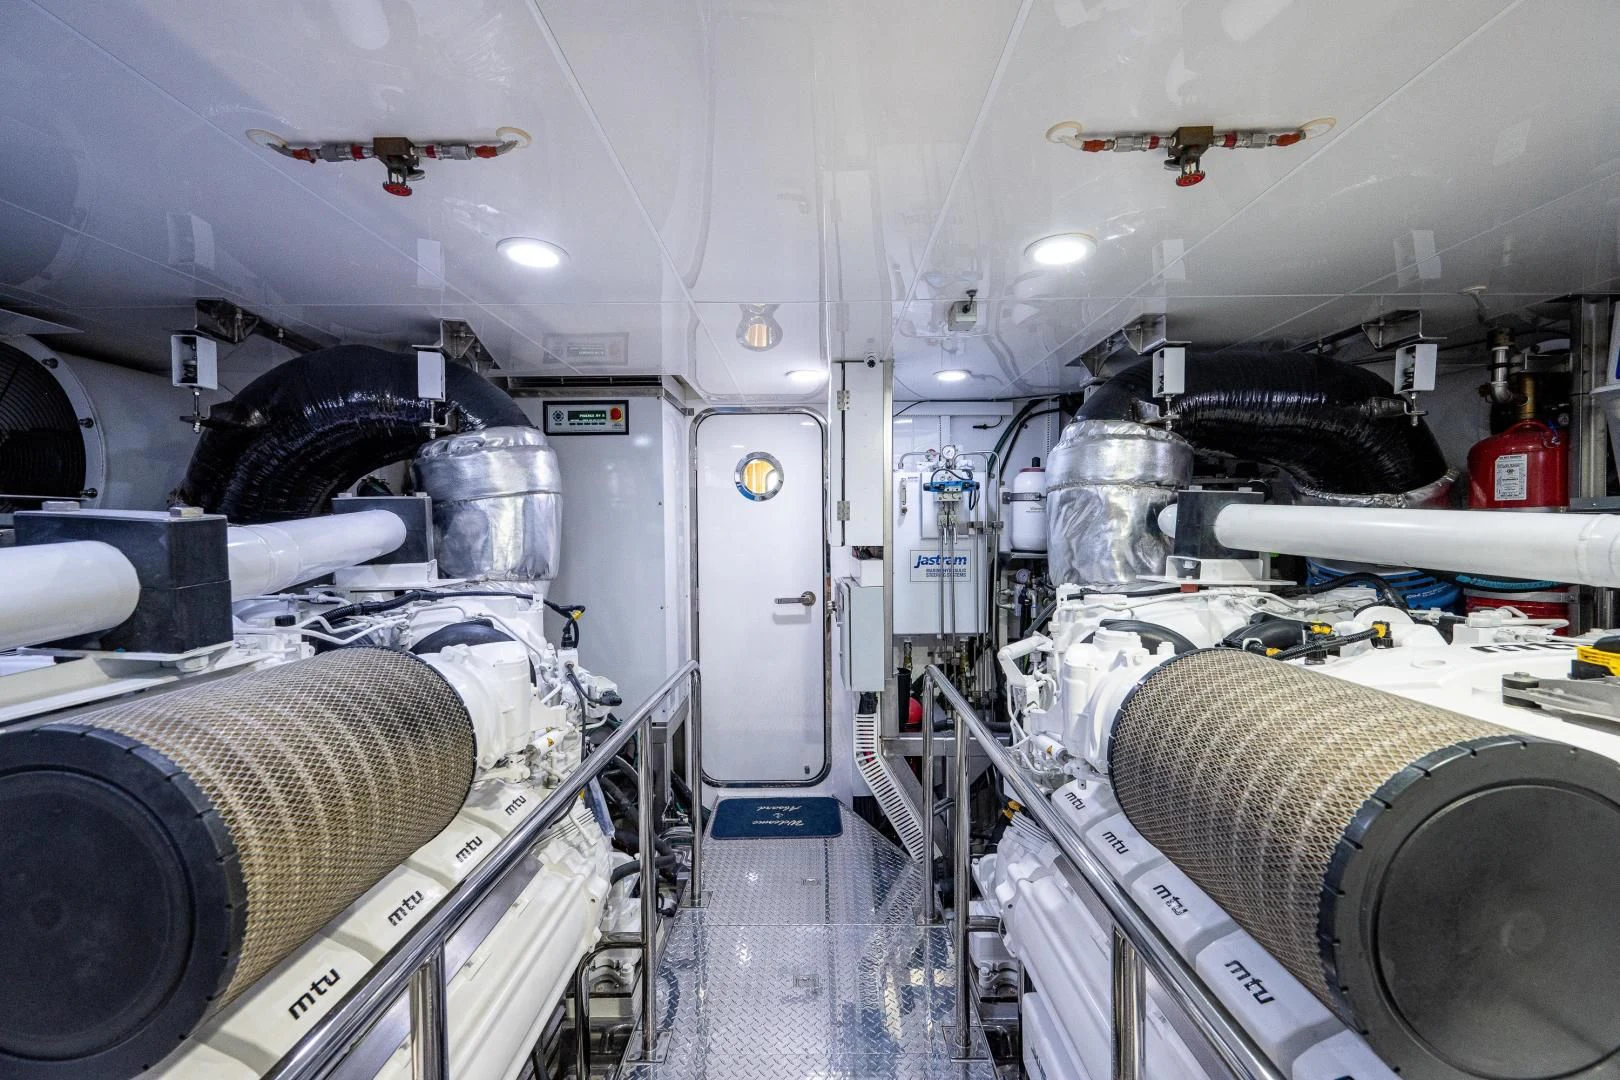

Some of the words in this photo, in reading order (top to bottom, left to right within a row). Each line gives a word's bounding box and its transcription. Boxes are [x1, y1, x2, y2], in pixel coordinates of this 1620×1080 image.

[914, 554, 967, 568] Jastram
[505, 795, 527, 816] mtu
[1064, 791, 1086, 811] mtu
[455, 835, 483, 863] mtu
[1102, 831, 1129, 855] mtu
[387, 890, 424, 927] mtu
[1152, 885, 1189, 916] mtu
[288, 968, 341, 1021] mtu
[1224, 960, 1276, 1005] mtu
